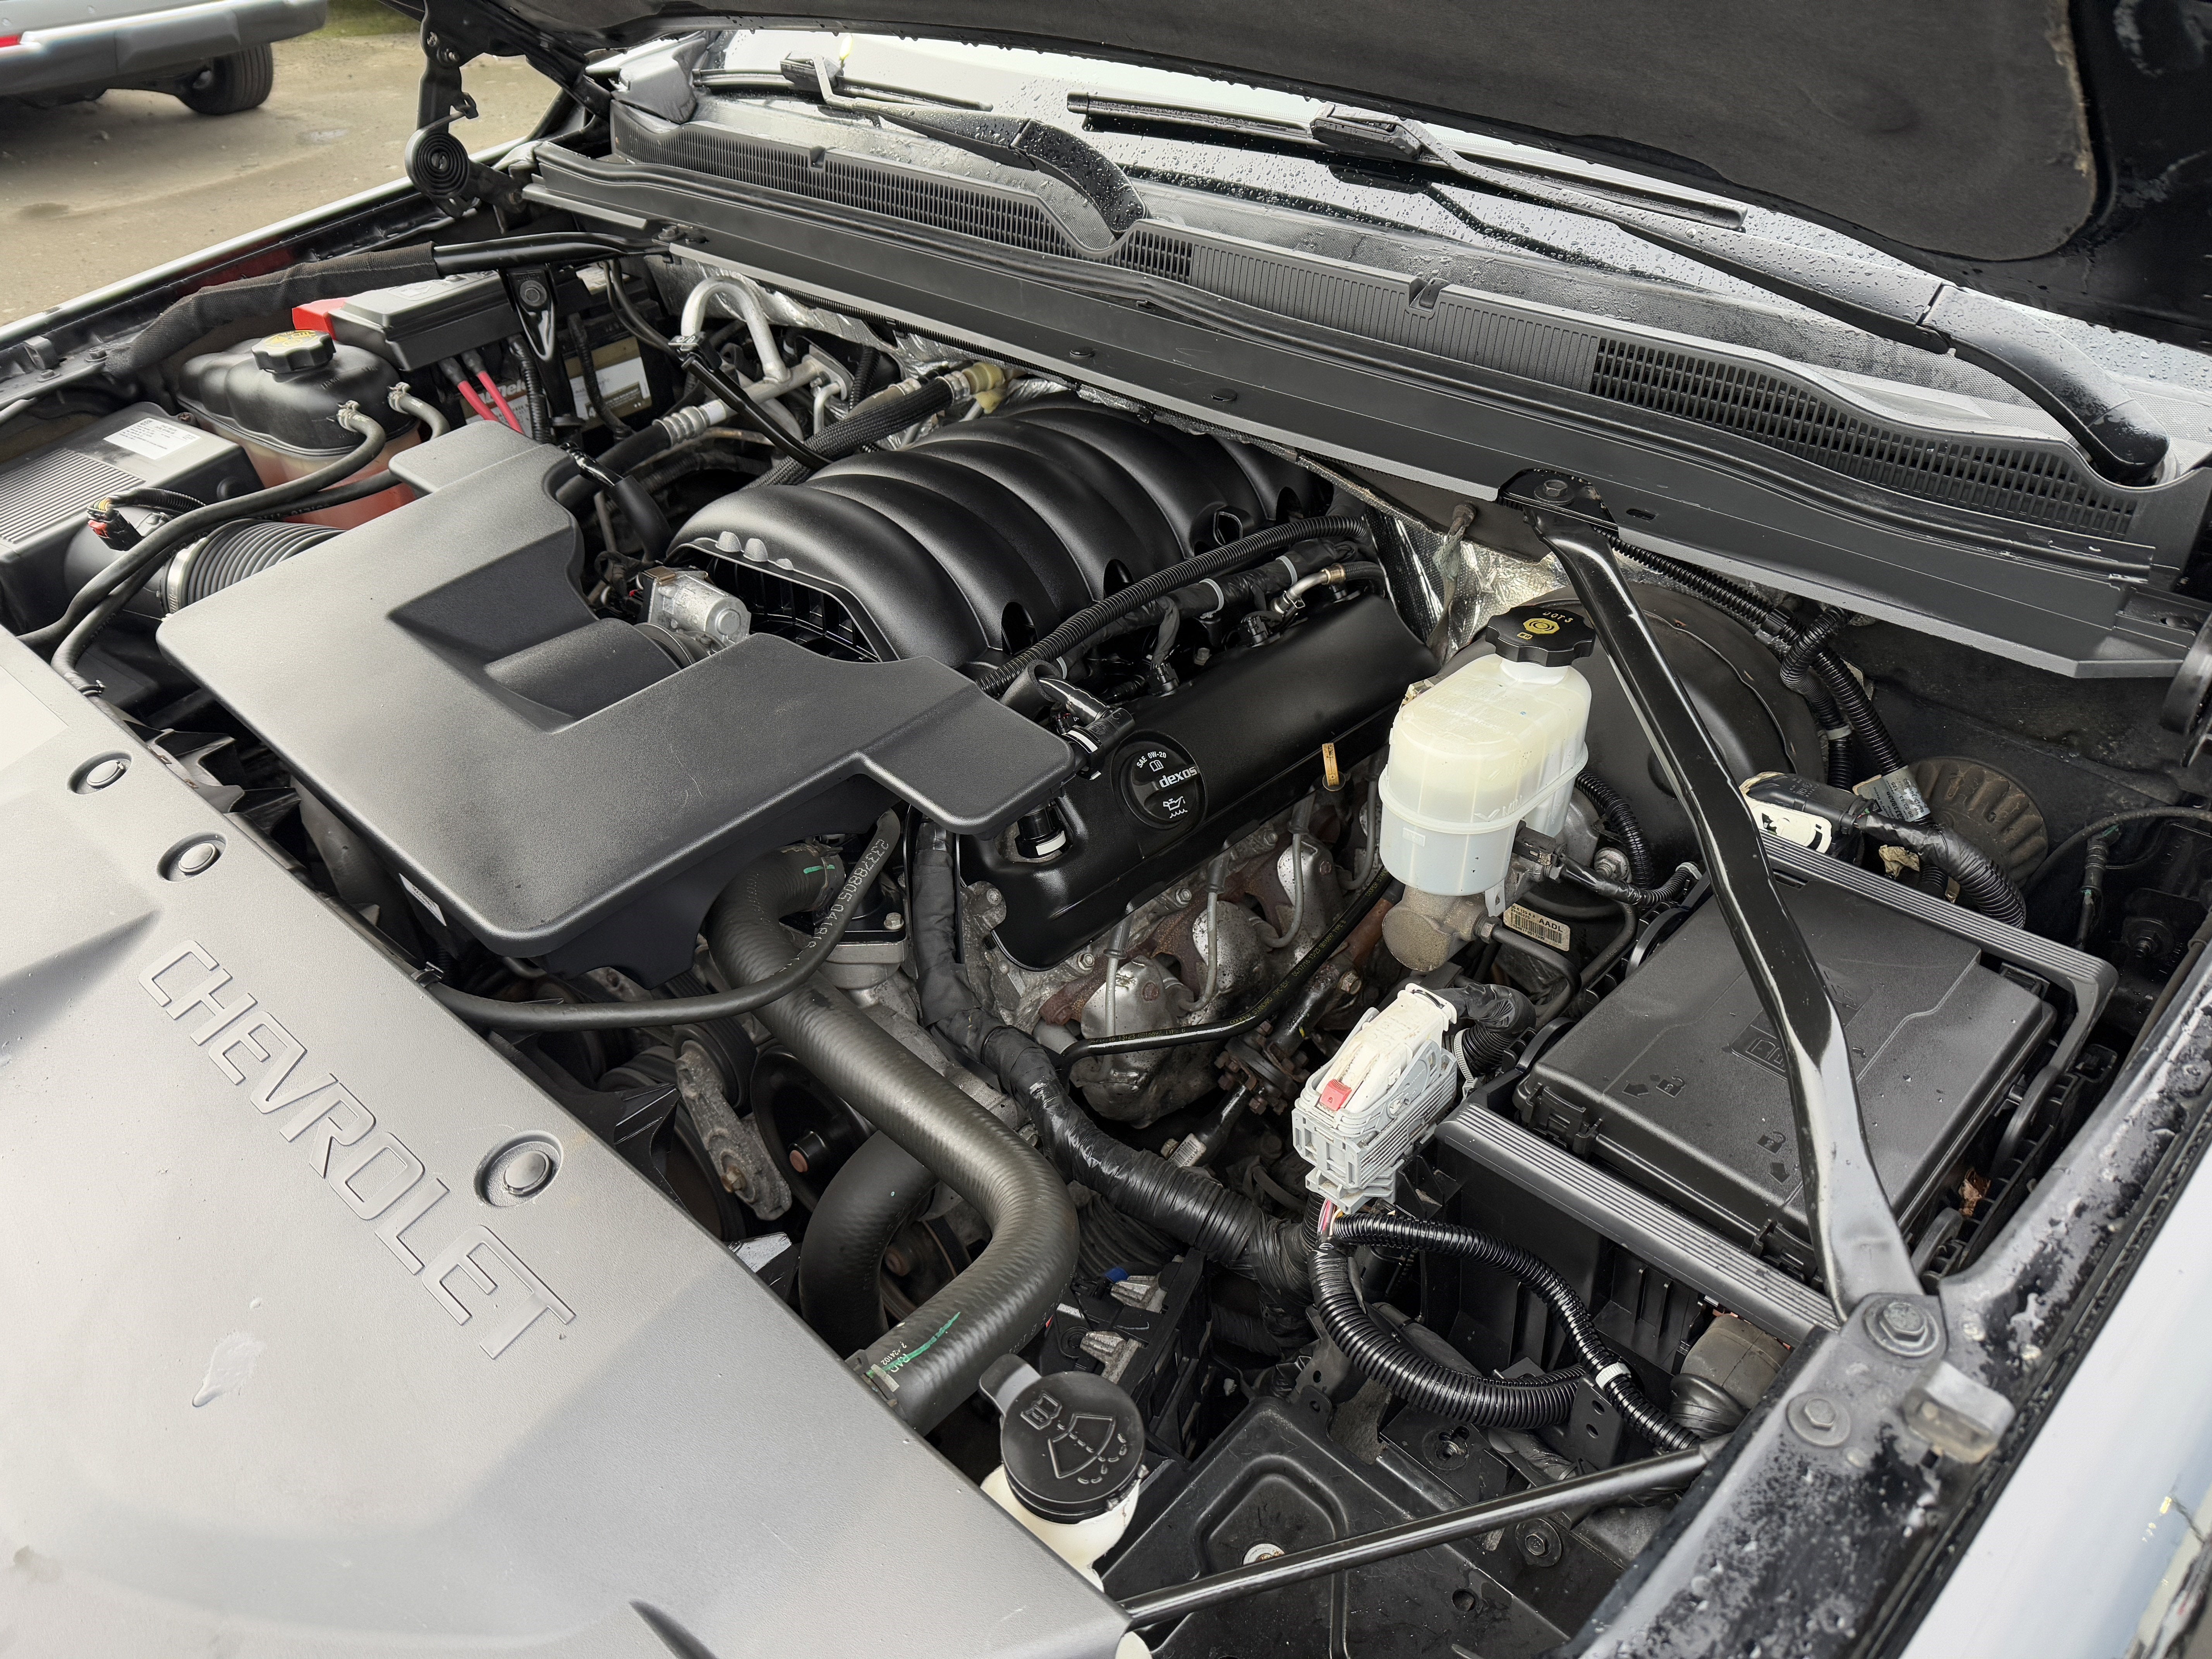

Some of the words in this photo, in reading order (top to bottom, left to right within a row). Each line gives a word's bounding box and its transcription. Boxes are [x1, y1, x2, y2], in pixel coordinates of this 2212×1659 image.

[1137, 756, 1147, 768] SAE
[1159, 766, 1197, 788] dexos
[837, 839, 889, 902] 23378805
[1539, 918, 1563, 933] AADL
[1230, 1013, 1251, 1024] COOPER
[1252, 997, 1273, 1015] STANDARD
[138, 940, 576, 1360] CHEVROLET
